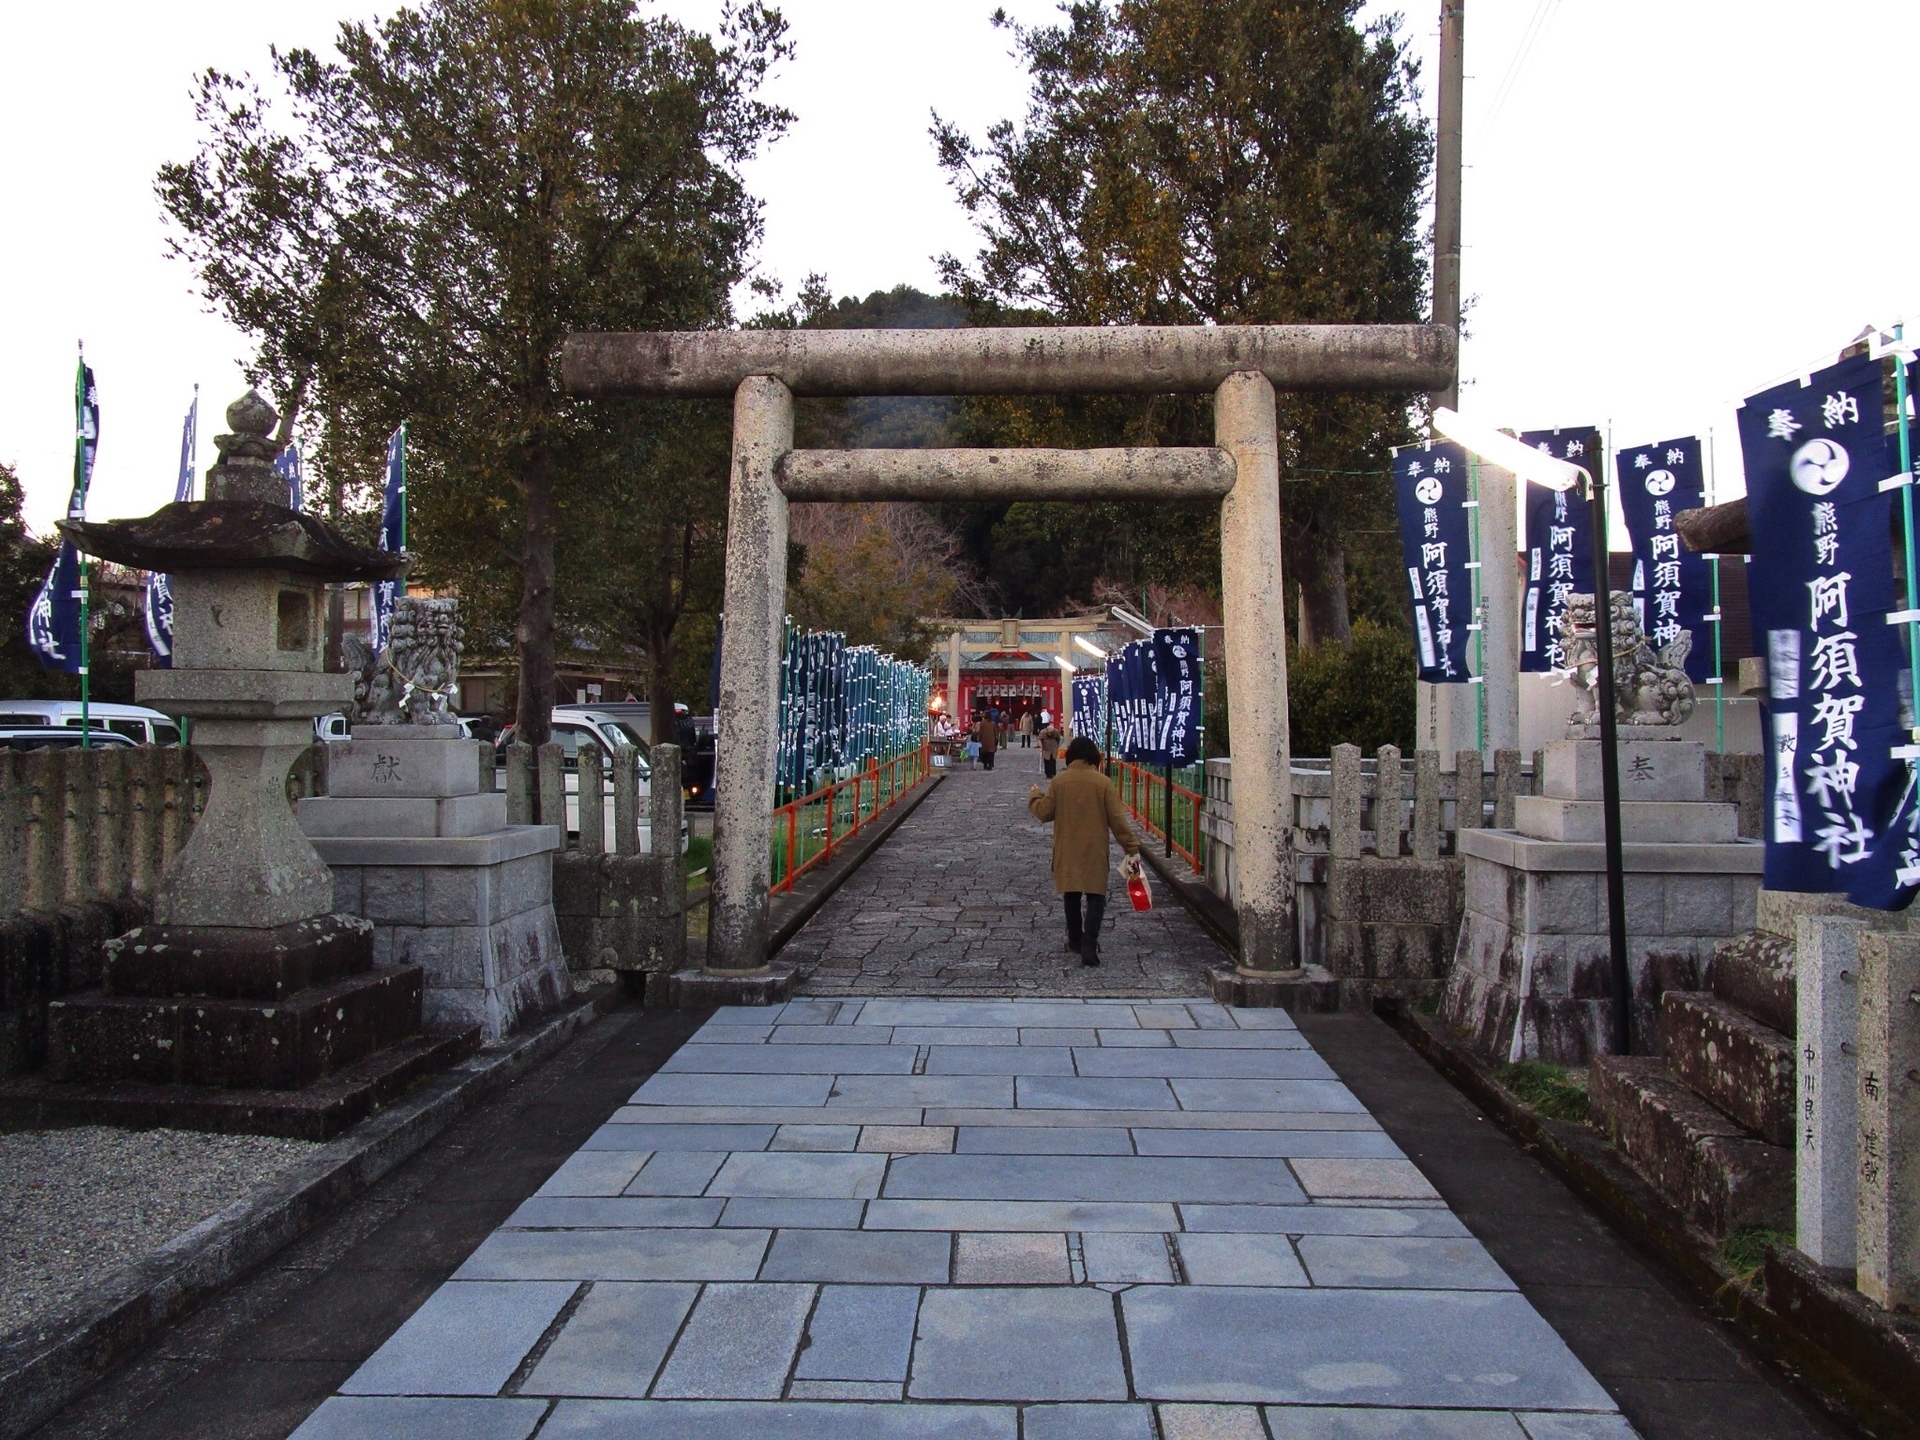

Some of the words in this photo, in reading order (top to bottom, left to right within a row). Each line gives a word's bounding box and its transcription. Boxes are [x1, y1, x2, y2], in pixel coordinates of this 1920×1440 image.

[1766, 391, 1860, 441] 奉納
[1407, 457, 1451, 477] 奉納
[1634, 448, 1684, 469] 奉納
[1804, 571, 1874, 870] 阿須賀神社
[1627, 754, 1656, 784] 奉
